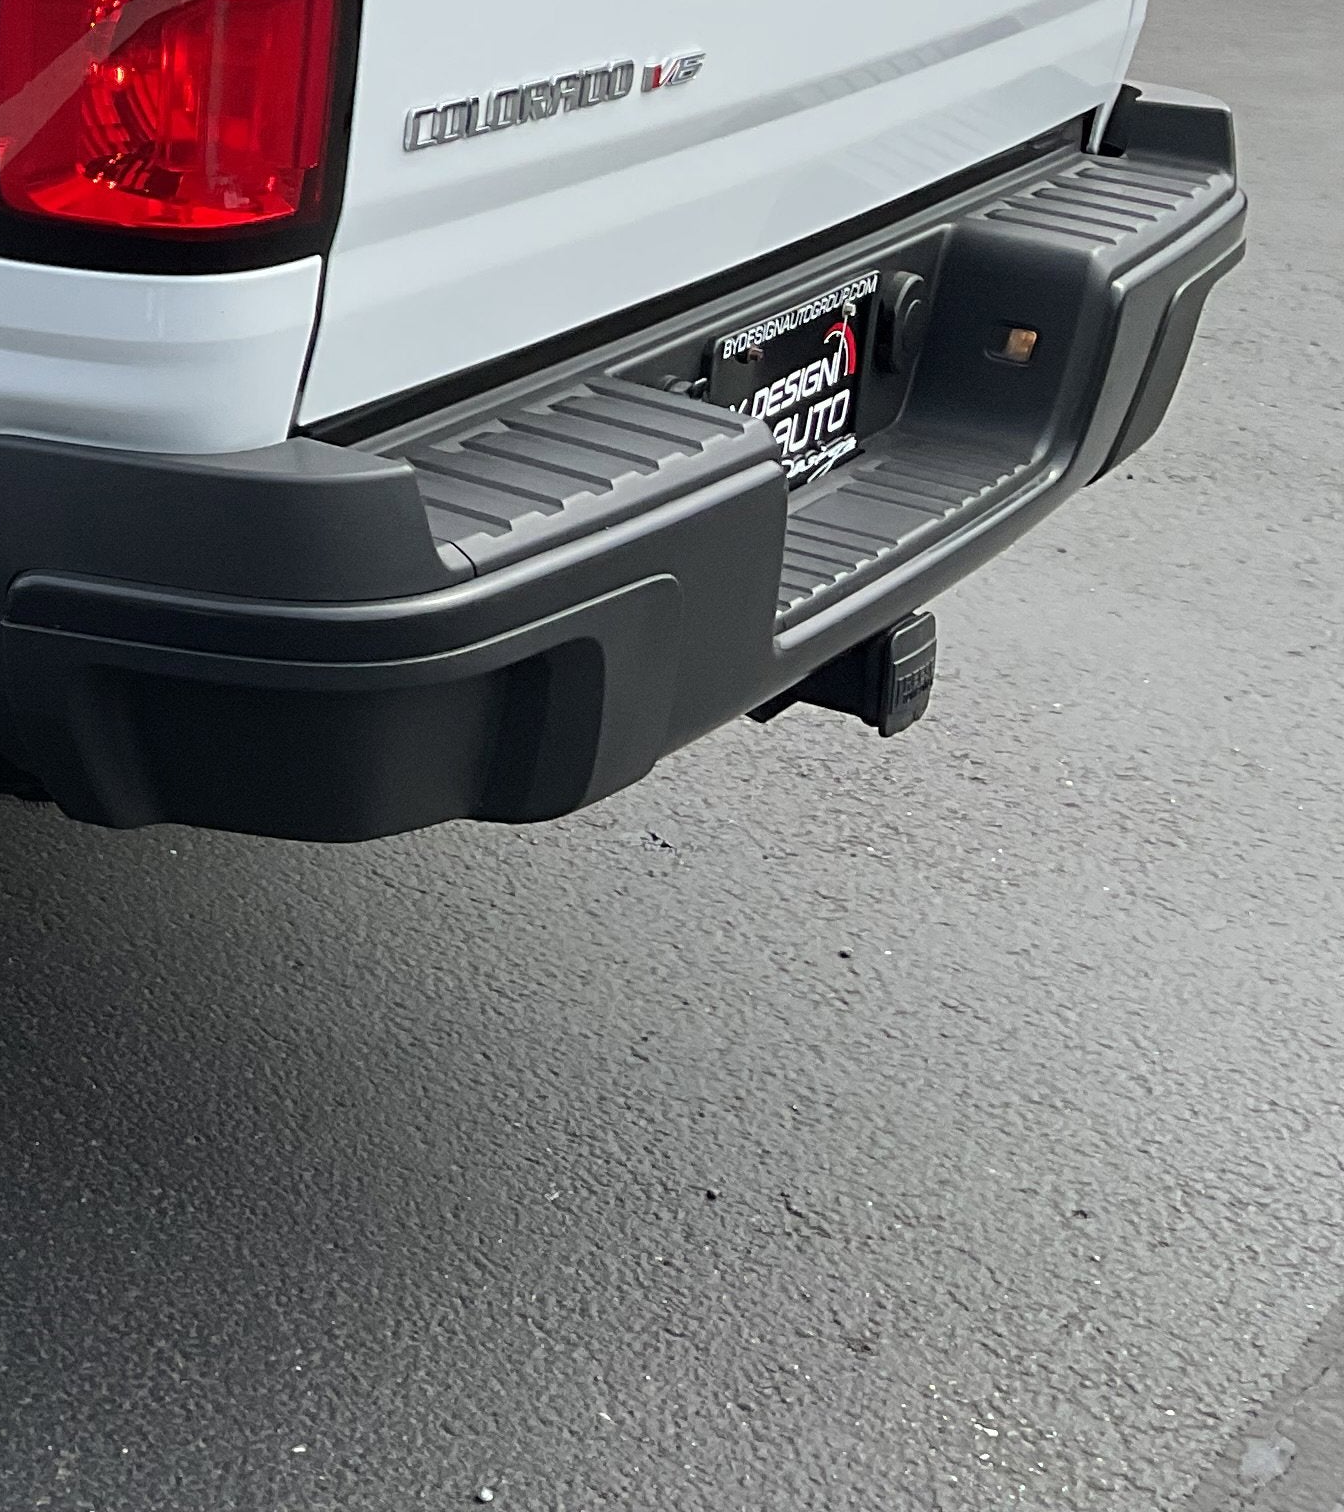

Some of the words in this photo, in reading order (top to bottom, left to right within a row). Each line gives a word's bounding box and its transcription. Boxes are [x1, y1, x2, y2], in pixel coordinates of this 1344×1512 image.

[403, 58, 634, 152] COLORADO
[641, 49, 706, 93] V6
[752, 352, 839, 421] DESIGN
[773, 389, 850, 457] AUTO
